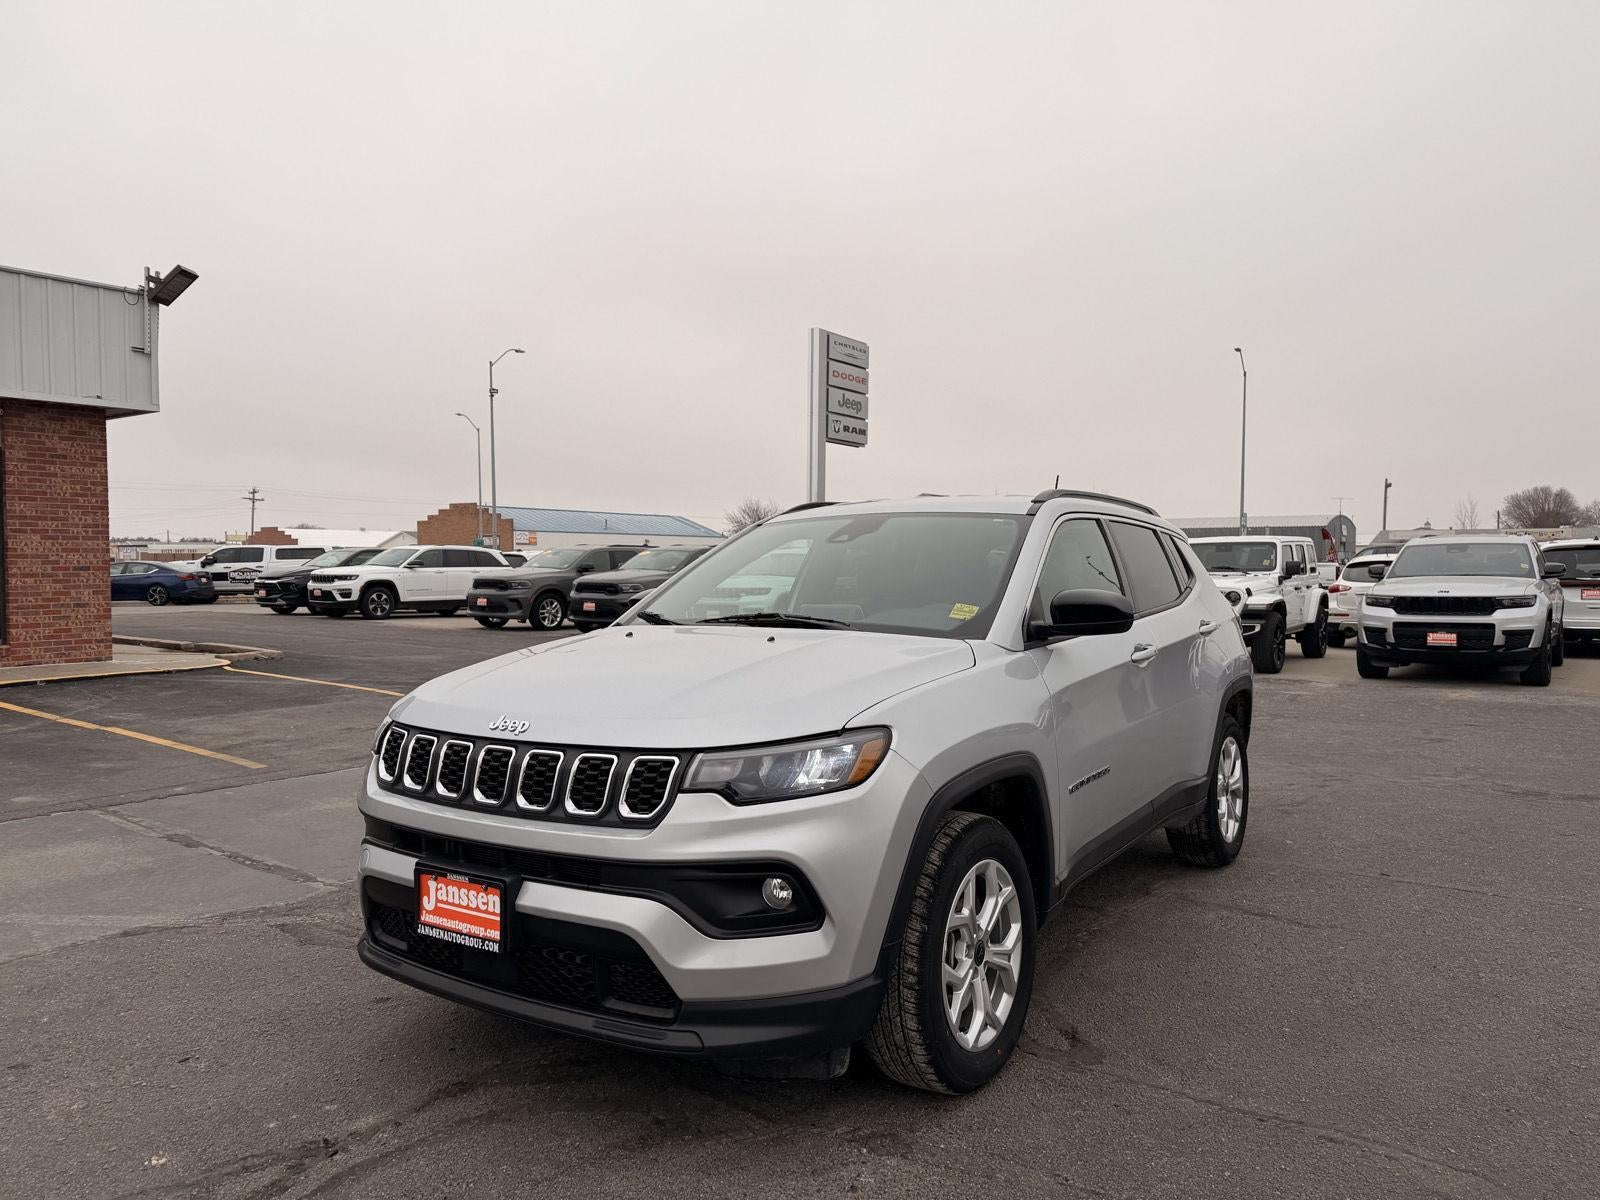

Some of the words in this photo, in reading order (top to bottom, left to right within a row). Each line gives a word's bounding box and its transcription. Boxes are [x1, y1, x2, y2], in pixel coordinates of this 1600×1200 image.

[833, 340, 867, 354] CHRYSLER
[832, 370, 867, 385] DODGE
[838, 393, 862, 414] Jeep
[843, 425, 867, 436] RAM
[489, 714, 530, 736] Jeep
[422, 880, 501, 914] Janssen
[420, 910, 500, 940] Janssenautogroup.com
